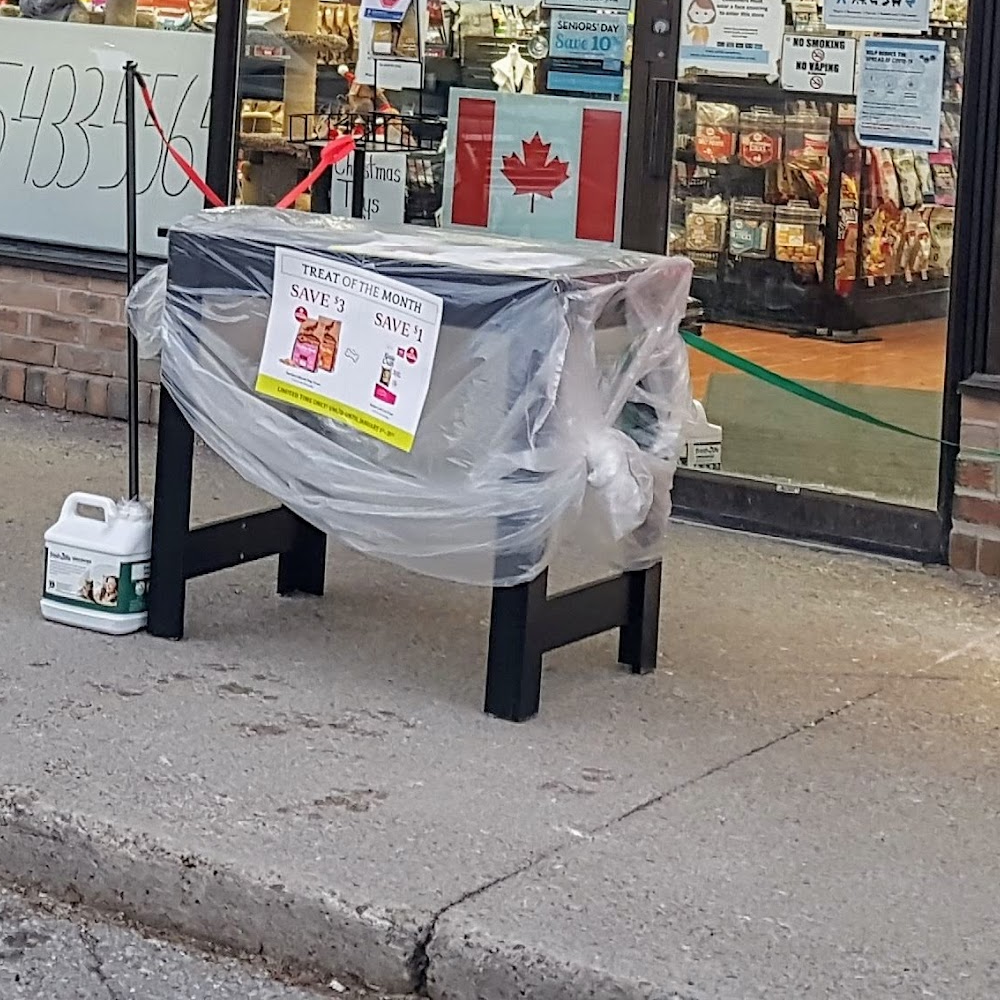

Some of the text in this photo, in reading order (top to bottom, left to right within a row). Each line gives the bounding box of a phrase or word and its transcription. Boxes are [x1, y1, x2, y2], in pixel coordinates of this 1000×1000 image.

[558, 20, 620, 33] SENIORS' DAY
[555, 32, 588, 50] Save
[793, 38, 846, 50] NO SMOKING
[796, 61, 840, 73] NO VAPING
[301, 263, 423, 314] TREAT OF THE MONTH
[290, 284, 345, 313] SAVE $3
[374, 312, 424, 343] SAVE $1
